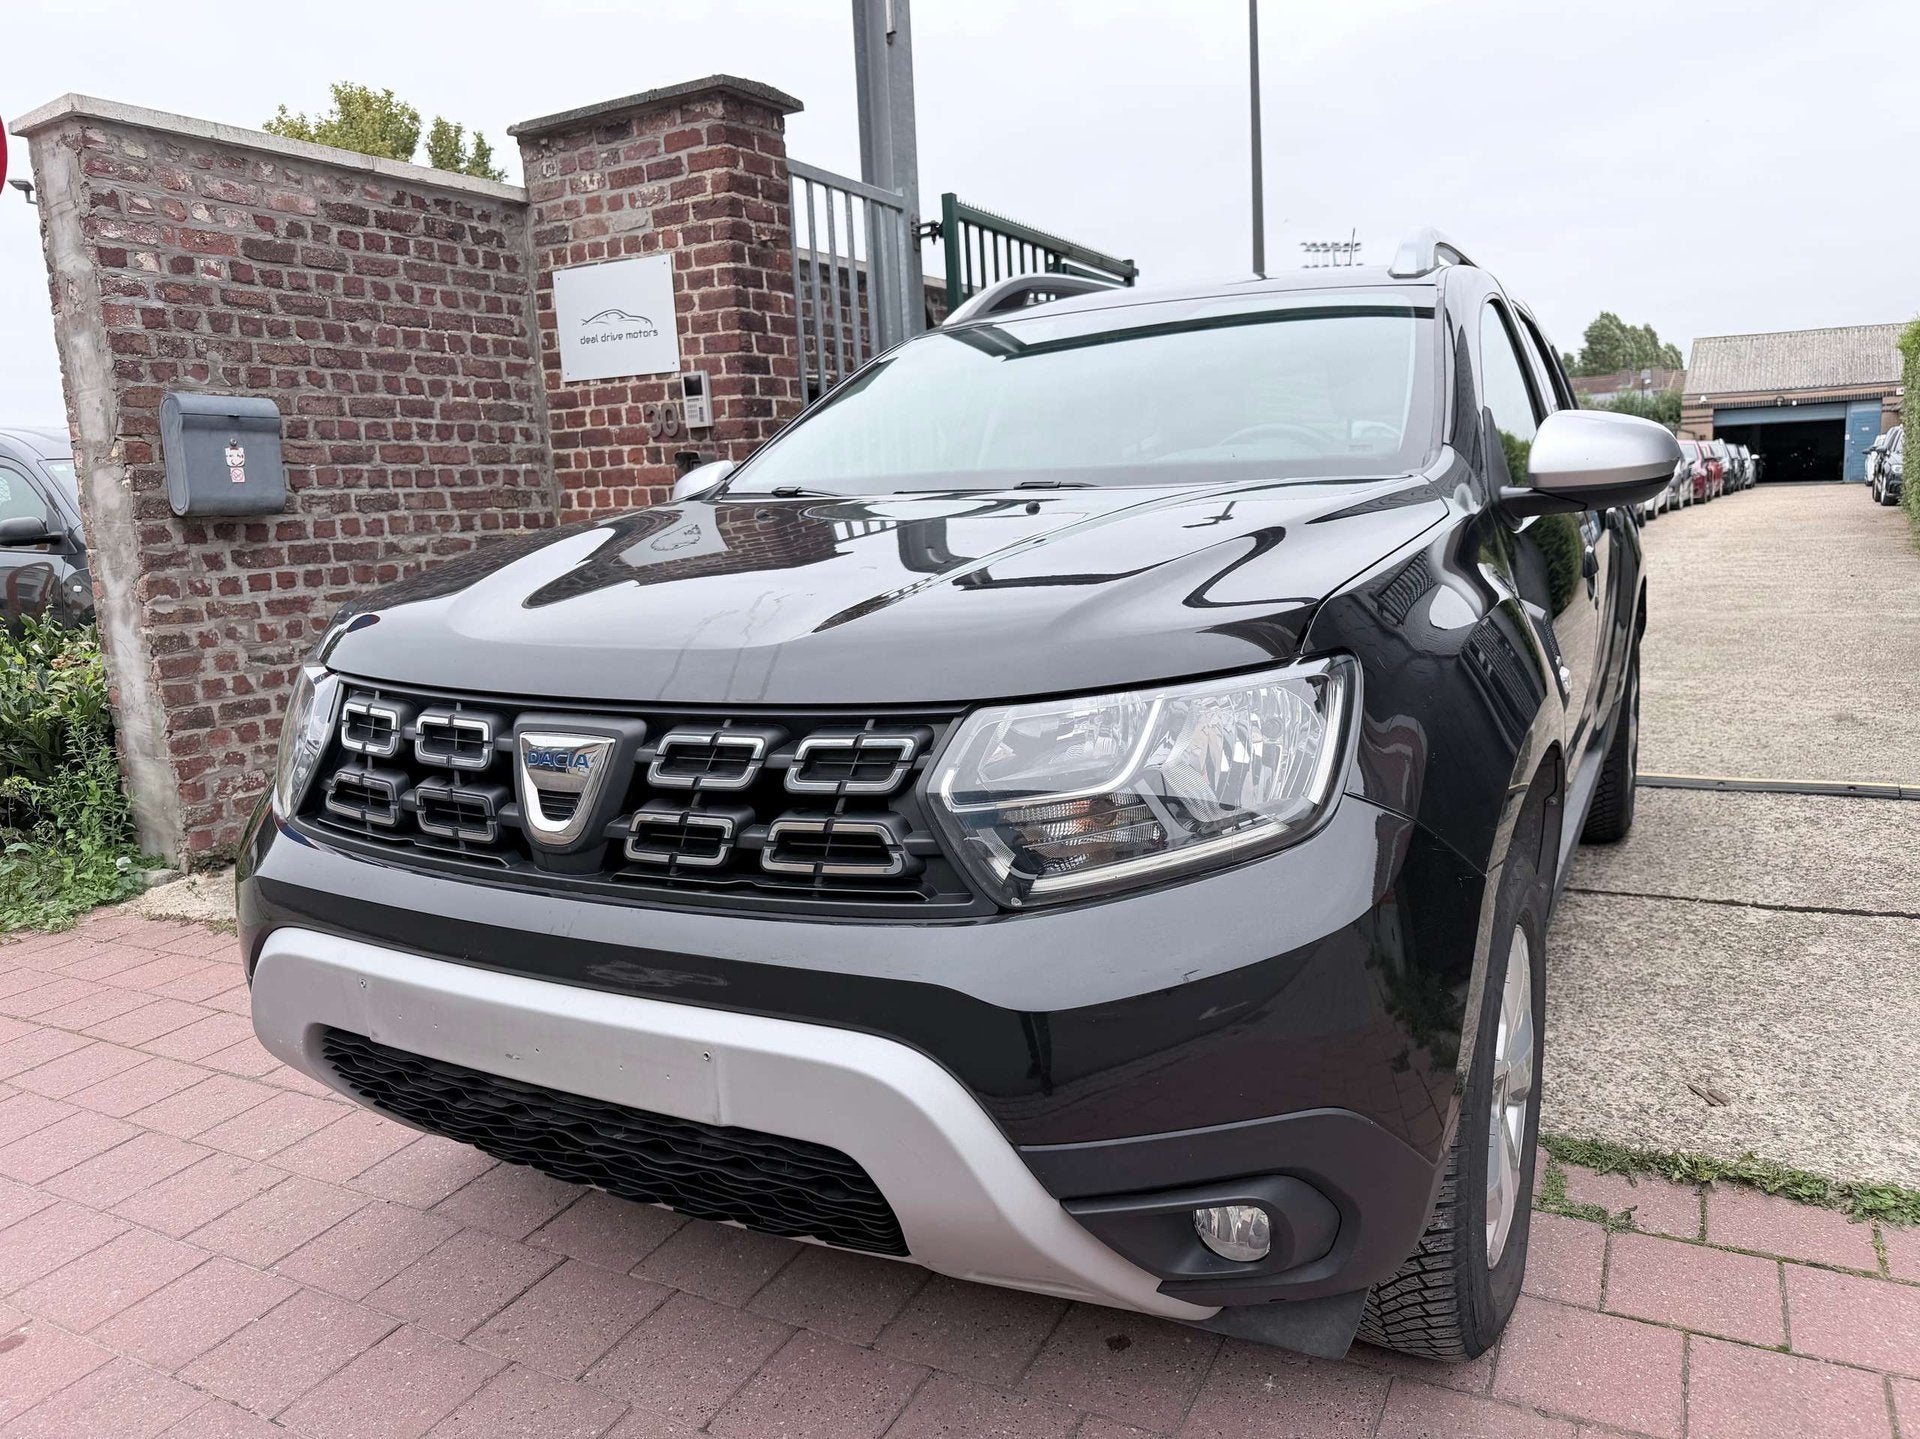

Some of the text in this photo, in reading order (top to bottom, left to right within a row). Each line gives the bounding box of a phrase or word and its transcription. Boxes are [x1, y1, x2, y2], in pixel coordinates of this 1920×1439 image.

[580, 329, 658, 345] deal drive motors
[645, 403, 679, 438] 30
[527, 750, 590, 769] DACIA
